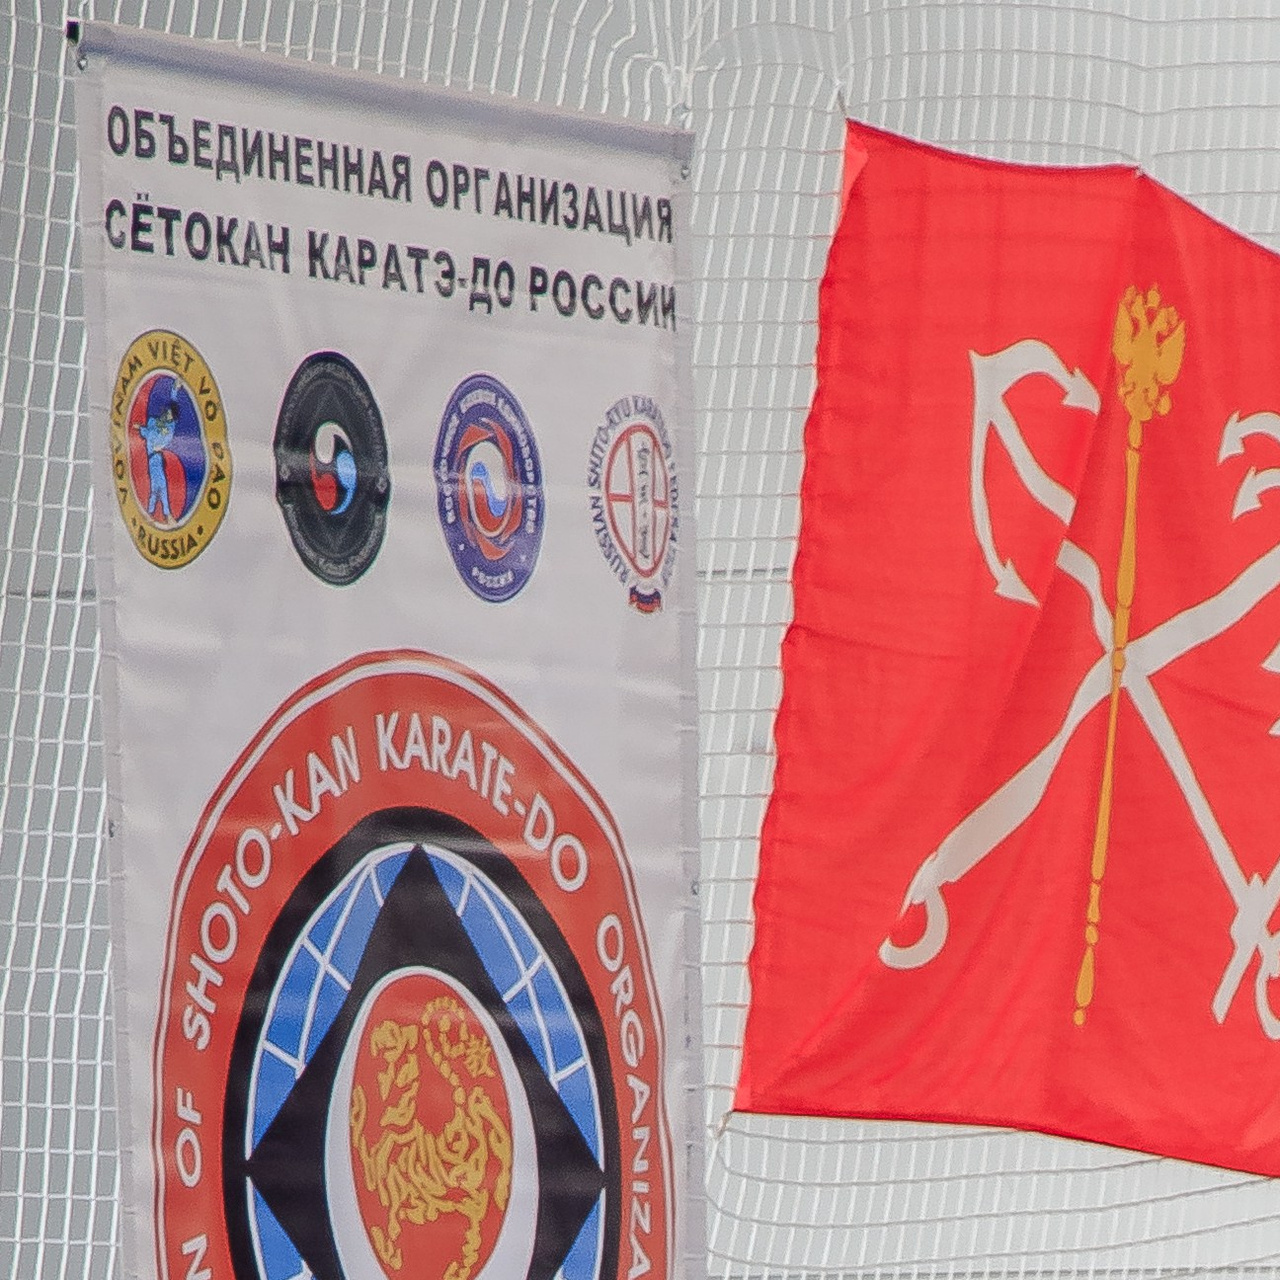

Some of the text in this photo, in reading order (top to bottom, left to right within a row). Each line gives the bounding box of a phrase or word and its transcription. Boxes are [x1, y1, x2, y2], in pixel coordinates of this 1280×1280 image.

[107, 105, 674, 246] ОБЪЕДИНЕННАЯ ОРГАНИЗАЦИЯ
[104, 192, 676, 332] СЁТОКАН КАРАТЭ-ДО РОССИИ
[137, 530, 198, 560] RUSSIA
[376, 713, 588, 892] KARATE-DO
[183, 726, 361, 1050] SHOTO-KAN
[175, 1088, 201, 1188] OF
